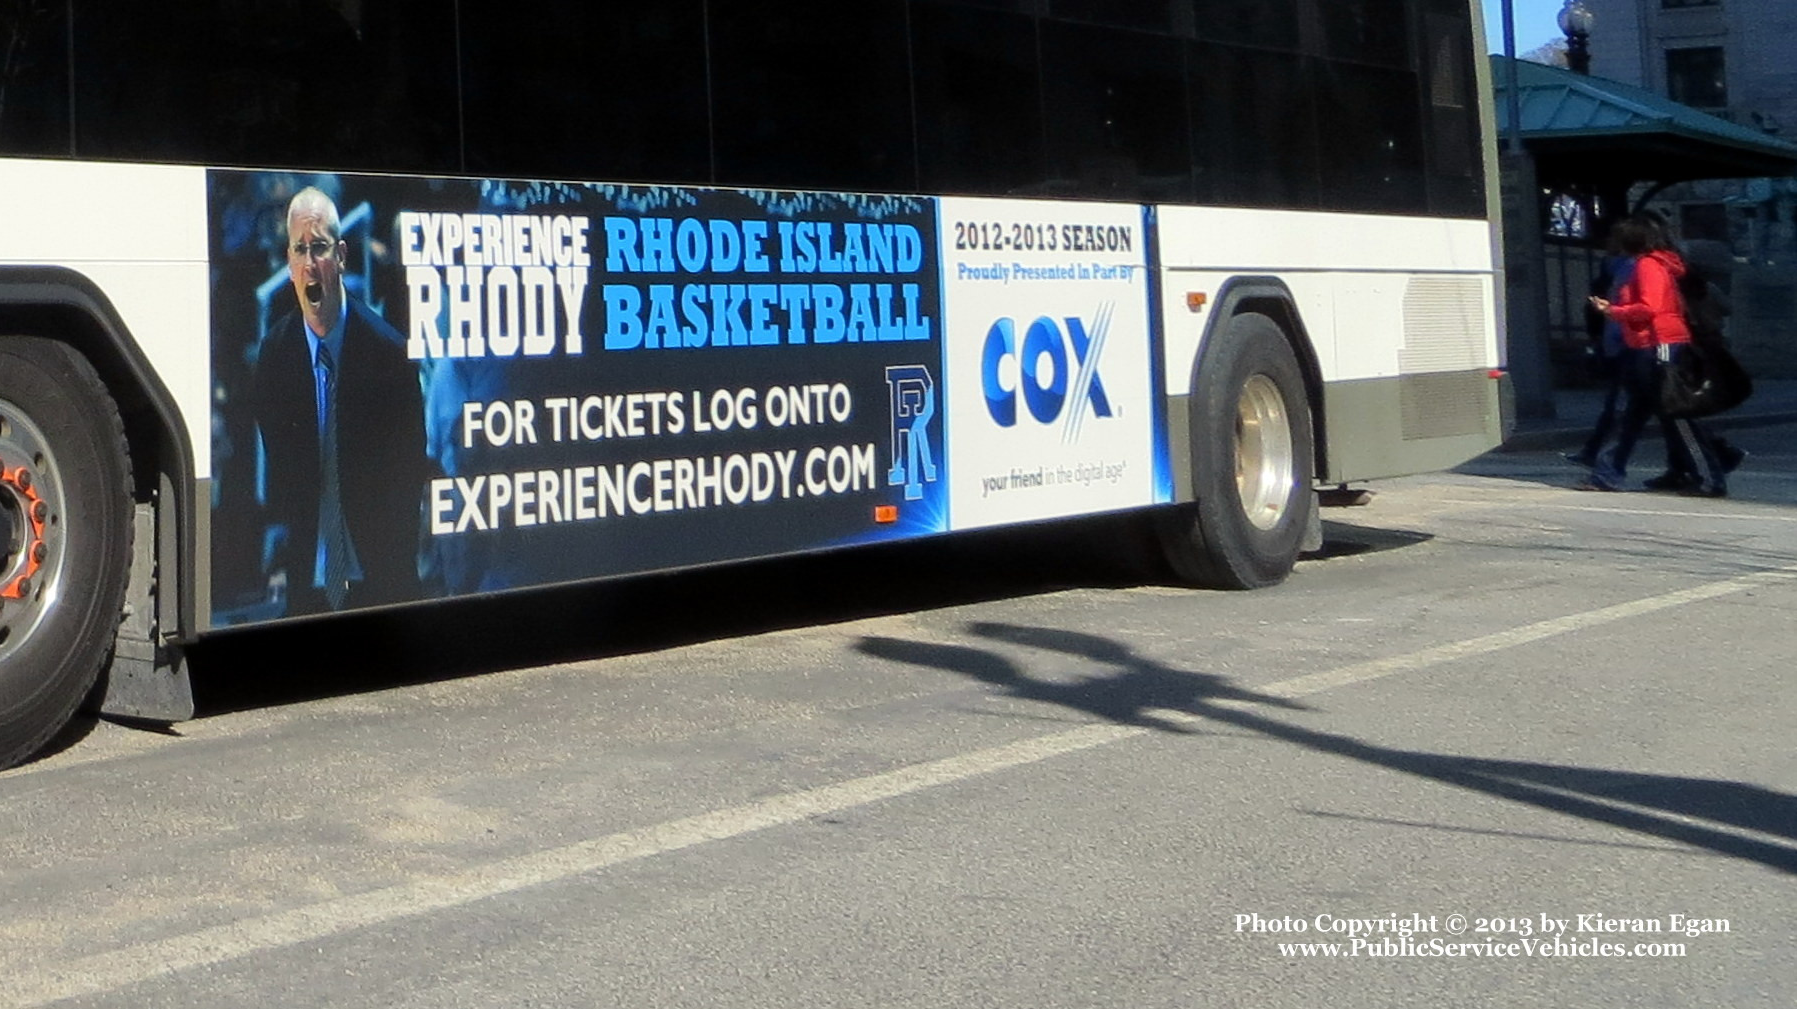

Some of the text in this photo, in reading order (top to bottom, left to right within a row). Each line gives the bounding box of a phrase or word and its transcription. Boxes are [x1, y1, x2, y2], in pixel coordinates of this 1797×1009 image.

[399, 211, 591, 267] EXPERIENCE
[604, 217, 923, 275] RHODE ISLAND
[955, 221, 1132, 253] 2012-2013 SEASON
[957, 264, 1010, 284] Proudly
[1013, 264, 1075, 281] Presented
[1078, 265, 1091, 280] In
[1093, 265, 1117, 281] Part
[407, 263, 588, 360] RHODY
[603, 282, 931, 350] BASKETBALL
[980, 304, 1115, 434] COX
[462, 383, 852, 449] FOR TICKETS LOG ONTO
[430, 444, 876, 536] EXPERIENCERHODY.COM
[982, 476, 1008, 498] your
[1010, 467, 1043, 489] friend
[1045, 467, 1056, 484] in
[1057, 464, 1072, 484] the
[1075, 460, 1104, 486] digital
